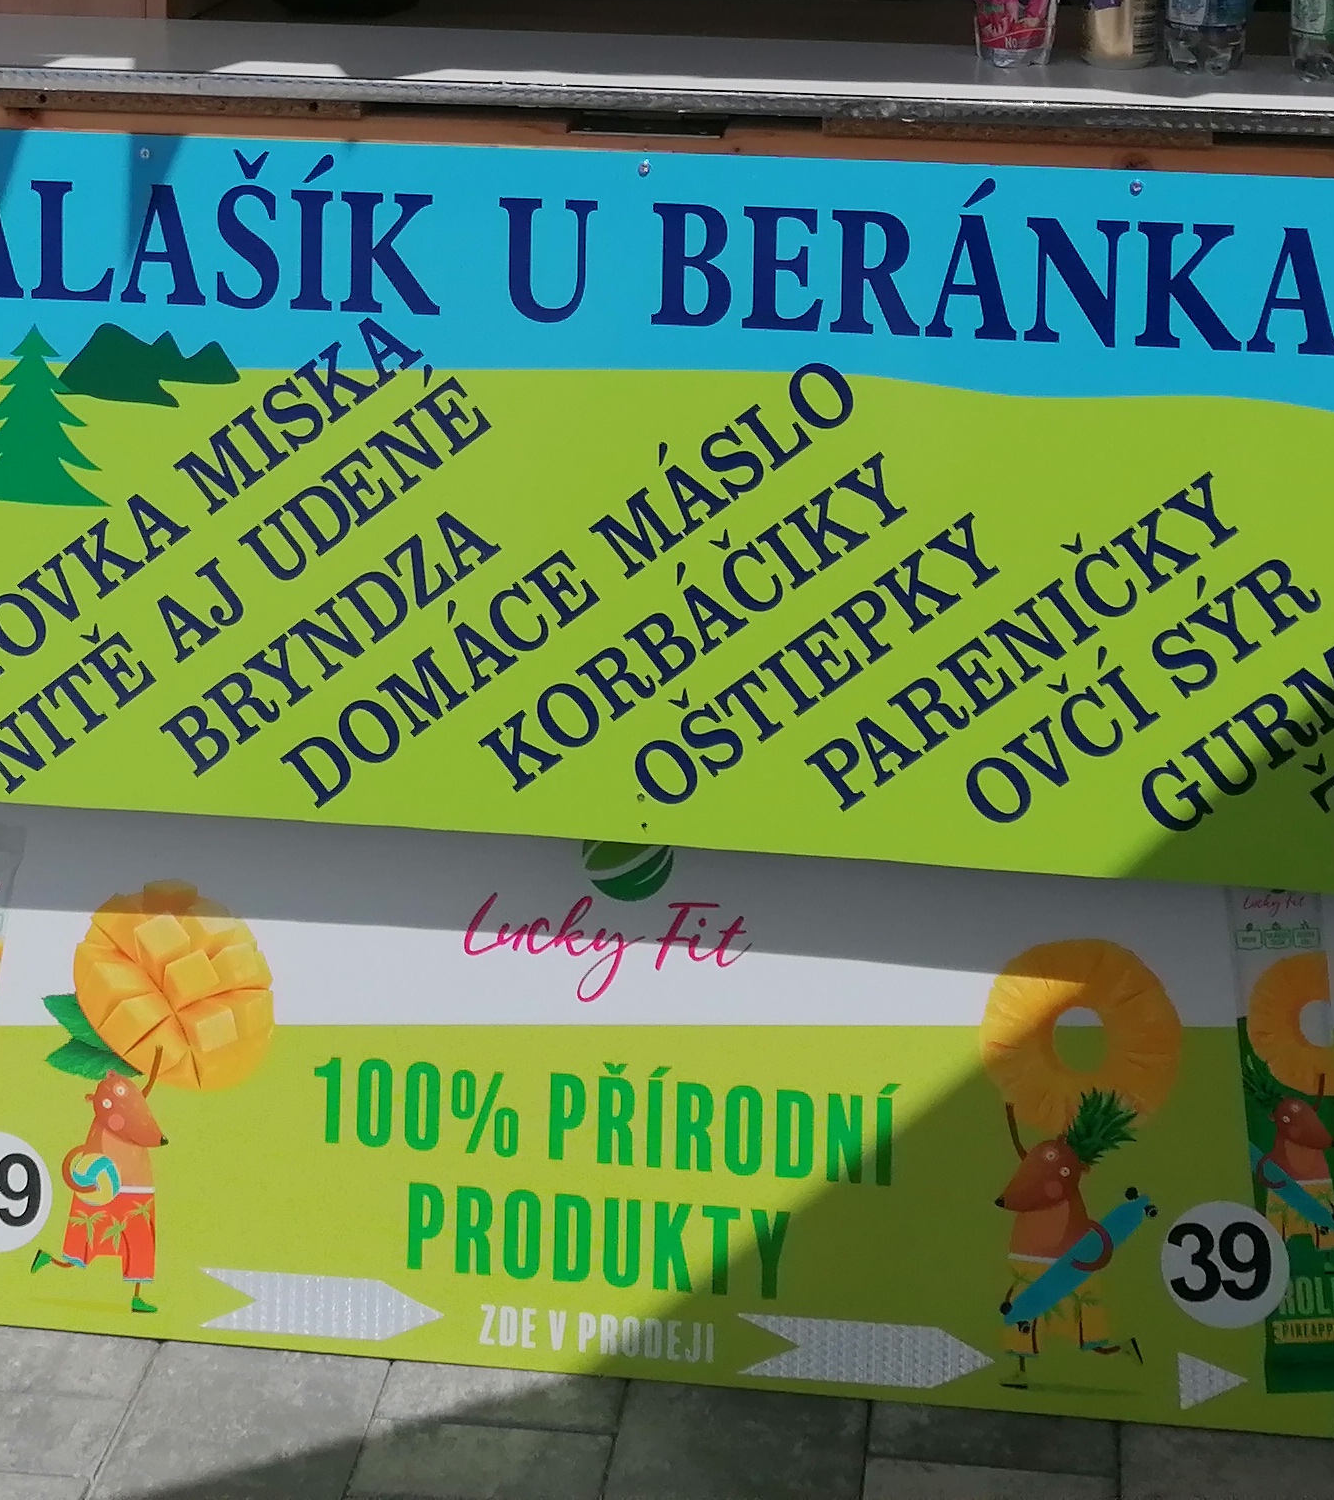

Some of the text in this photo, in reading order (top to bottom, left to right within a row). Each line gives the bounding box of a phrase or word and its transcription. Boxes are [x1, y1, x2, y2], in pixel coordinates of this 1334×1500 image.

[498, 195, 599, 324] U
[167, 560, 249, 662] AJ
[238, 363, 493, 584] UDENÉ
[173, 314, 427, 515] MISKA
[158, 508, 503, 778] BRYNDZA
[280, 361, 855, 809] DOMÁCE MÁSLO
[477, 452, 908, 794] KORBÁČIKY
[633, 512, 1002, 807] OŠTIEPKY
[803, 471, 1241, 813] PARENIČKY
[963, 556, 1322, 826] OVČÍ SÝR
[463, 892, 754, 1003] Lucky Fit
[313, 1055, 903, 1188] 100% PŘÍRODNÍ
[405, 1181, 792, 1299] PRODUKTY
[478, 1302, 716, 1365] ZDE V PRODEJI
[1167, 1220, 1271, 1302] 39
